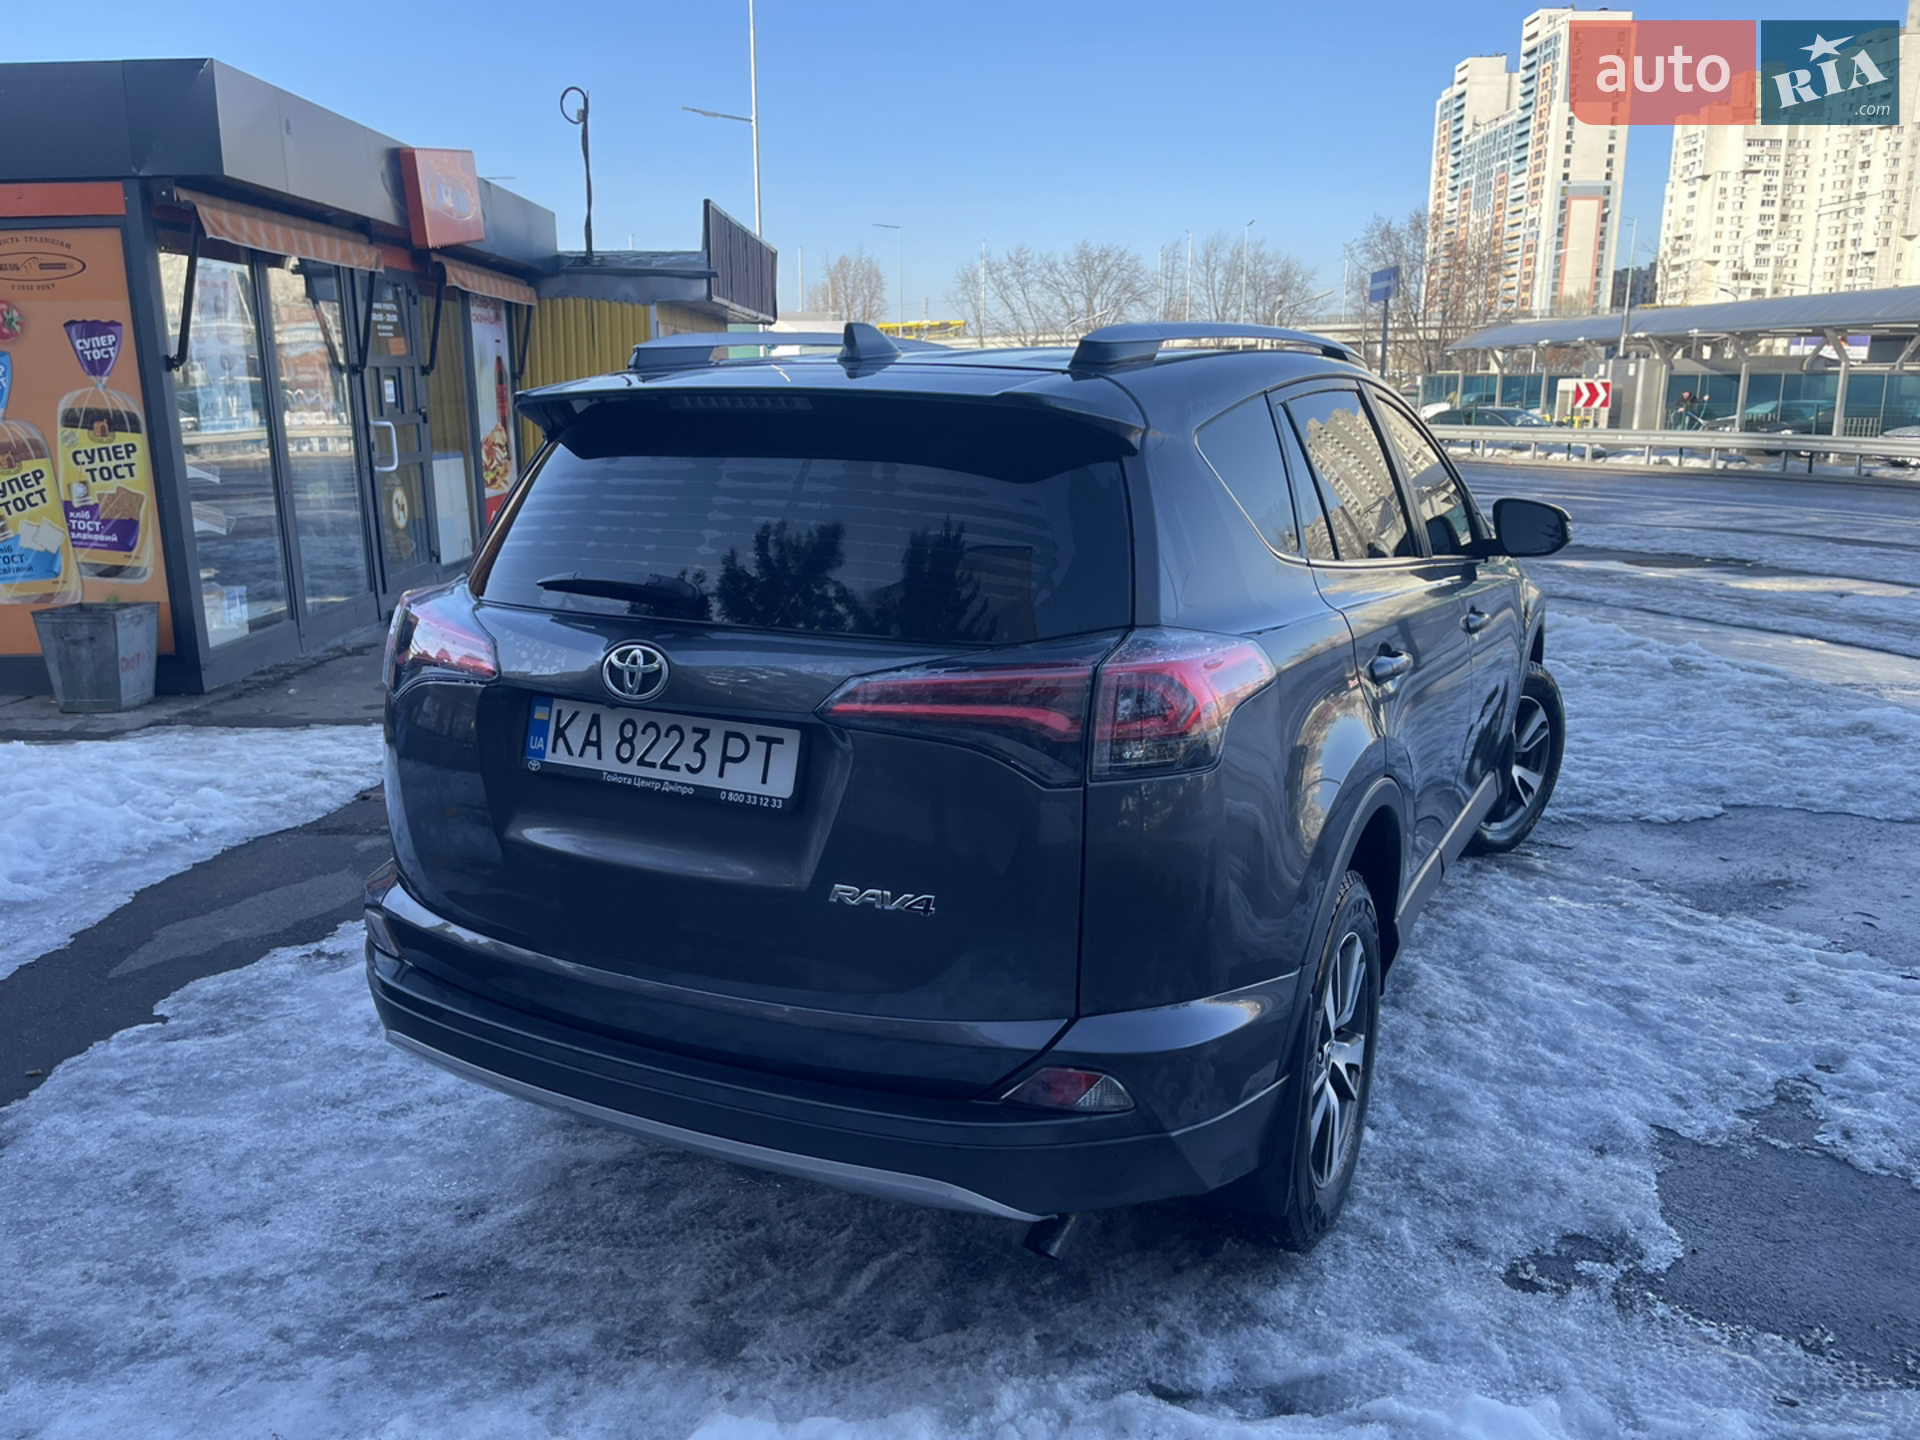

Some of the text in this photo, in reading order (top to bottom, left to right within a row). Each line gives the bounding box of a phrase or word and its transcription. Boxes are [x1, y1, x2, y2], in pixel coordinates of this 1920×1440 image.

[75, 334, 116, 350] СУПЕР
[84, 347, 115, 361] ТОСТ
[72, 443, 138, 466] СУПЕР
[85, 463, 136, 483] ТОСТ
[0, 487, 47, 516] ТОСТ
[69, 511, 91, 520] хліб
[70, 532, 119, 543] злаковий
[0, 553, 24, 566] ОСТ
[529, 735, 545, 751] UA
[552, 708, 785, 785] KA 8223 PT
[602, 771, 695, 796] Тойота Центр Дніпро
[727, 792, 744, 804] 800
[745, 795, 757, 806] 33
[759, 797, 769, 807] 12
[771, 799, 783, 809] 33
[828, 884, 936, 916] RAV4
